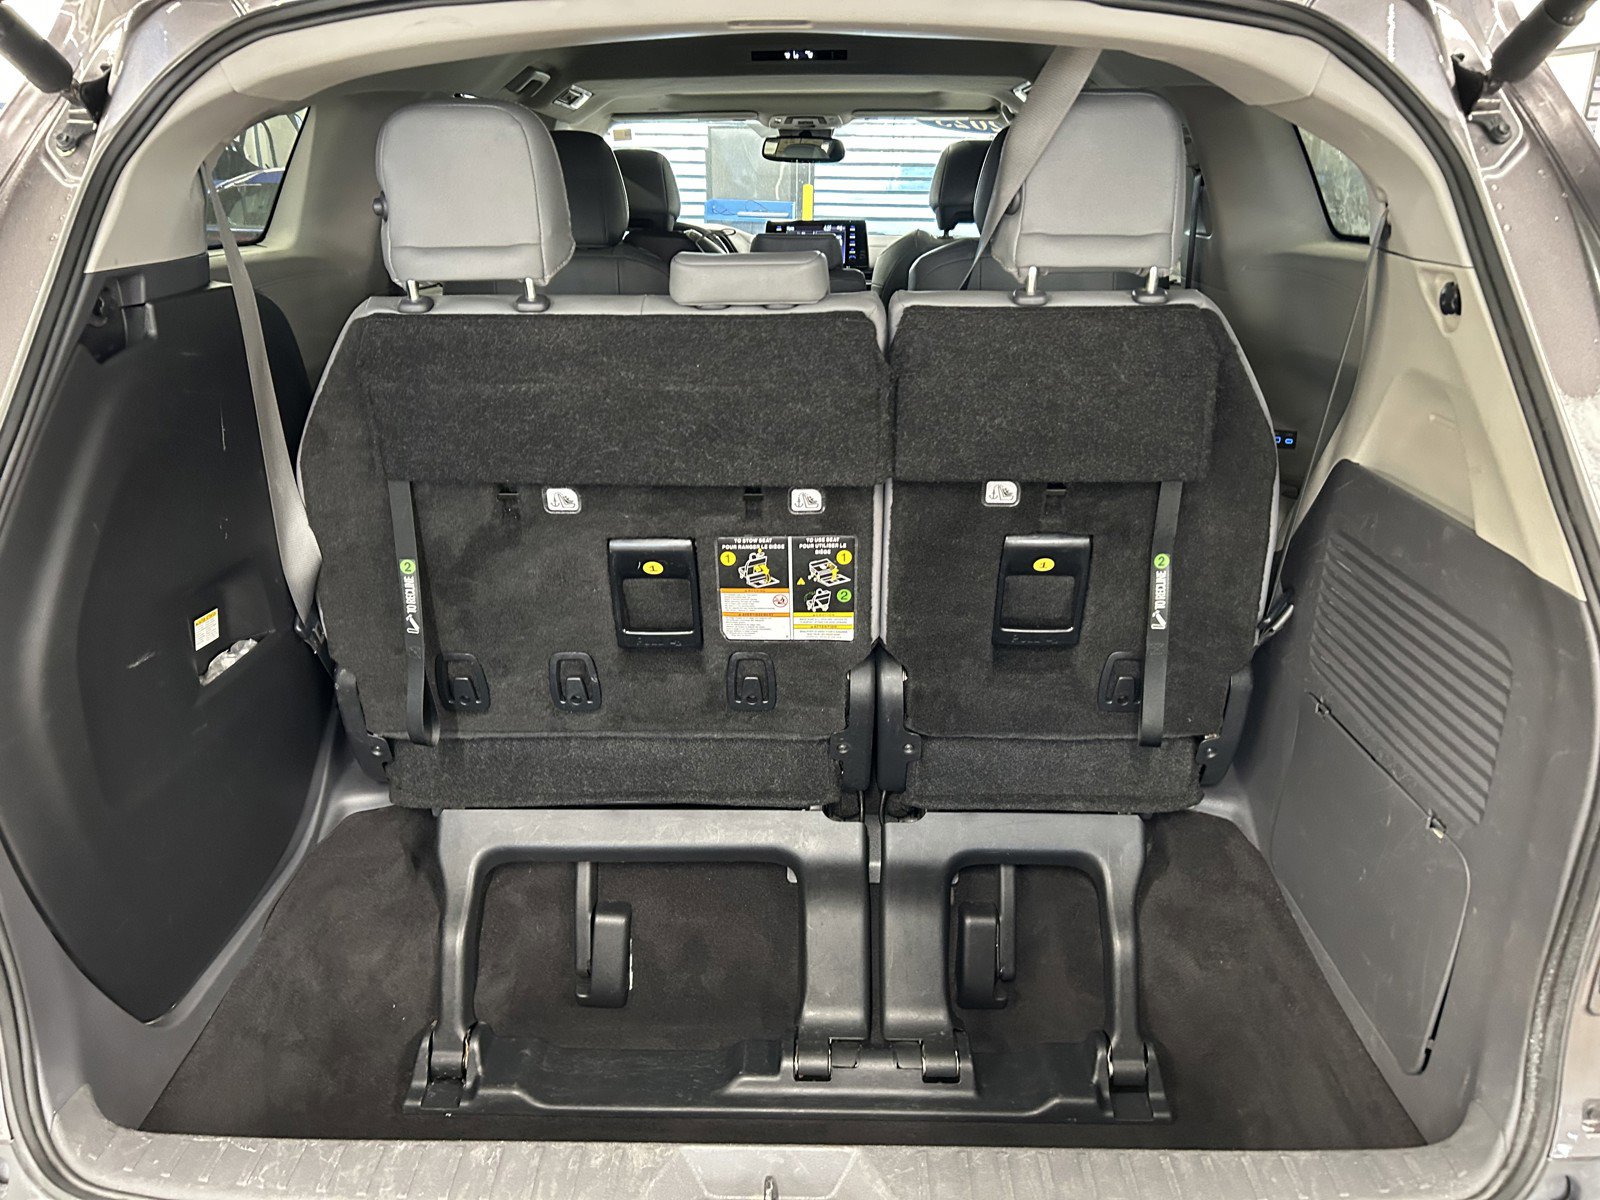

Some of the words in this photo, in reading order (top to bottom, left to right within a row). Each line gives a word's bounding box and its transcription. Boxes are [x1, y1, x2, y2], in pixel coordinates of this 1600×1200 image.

[403, 575, 416, 604] RECLINE
[1155, 570, 1167, 600] RECLINE
[405, 604, 417, 614] TO
[1155, 600, 1166, 610] TO
